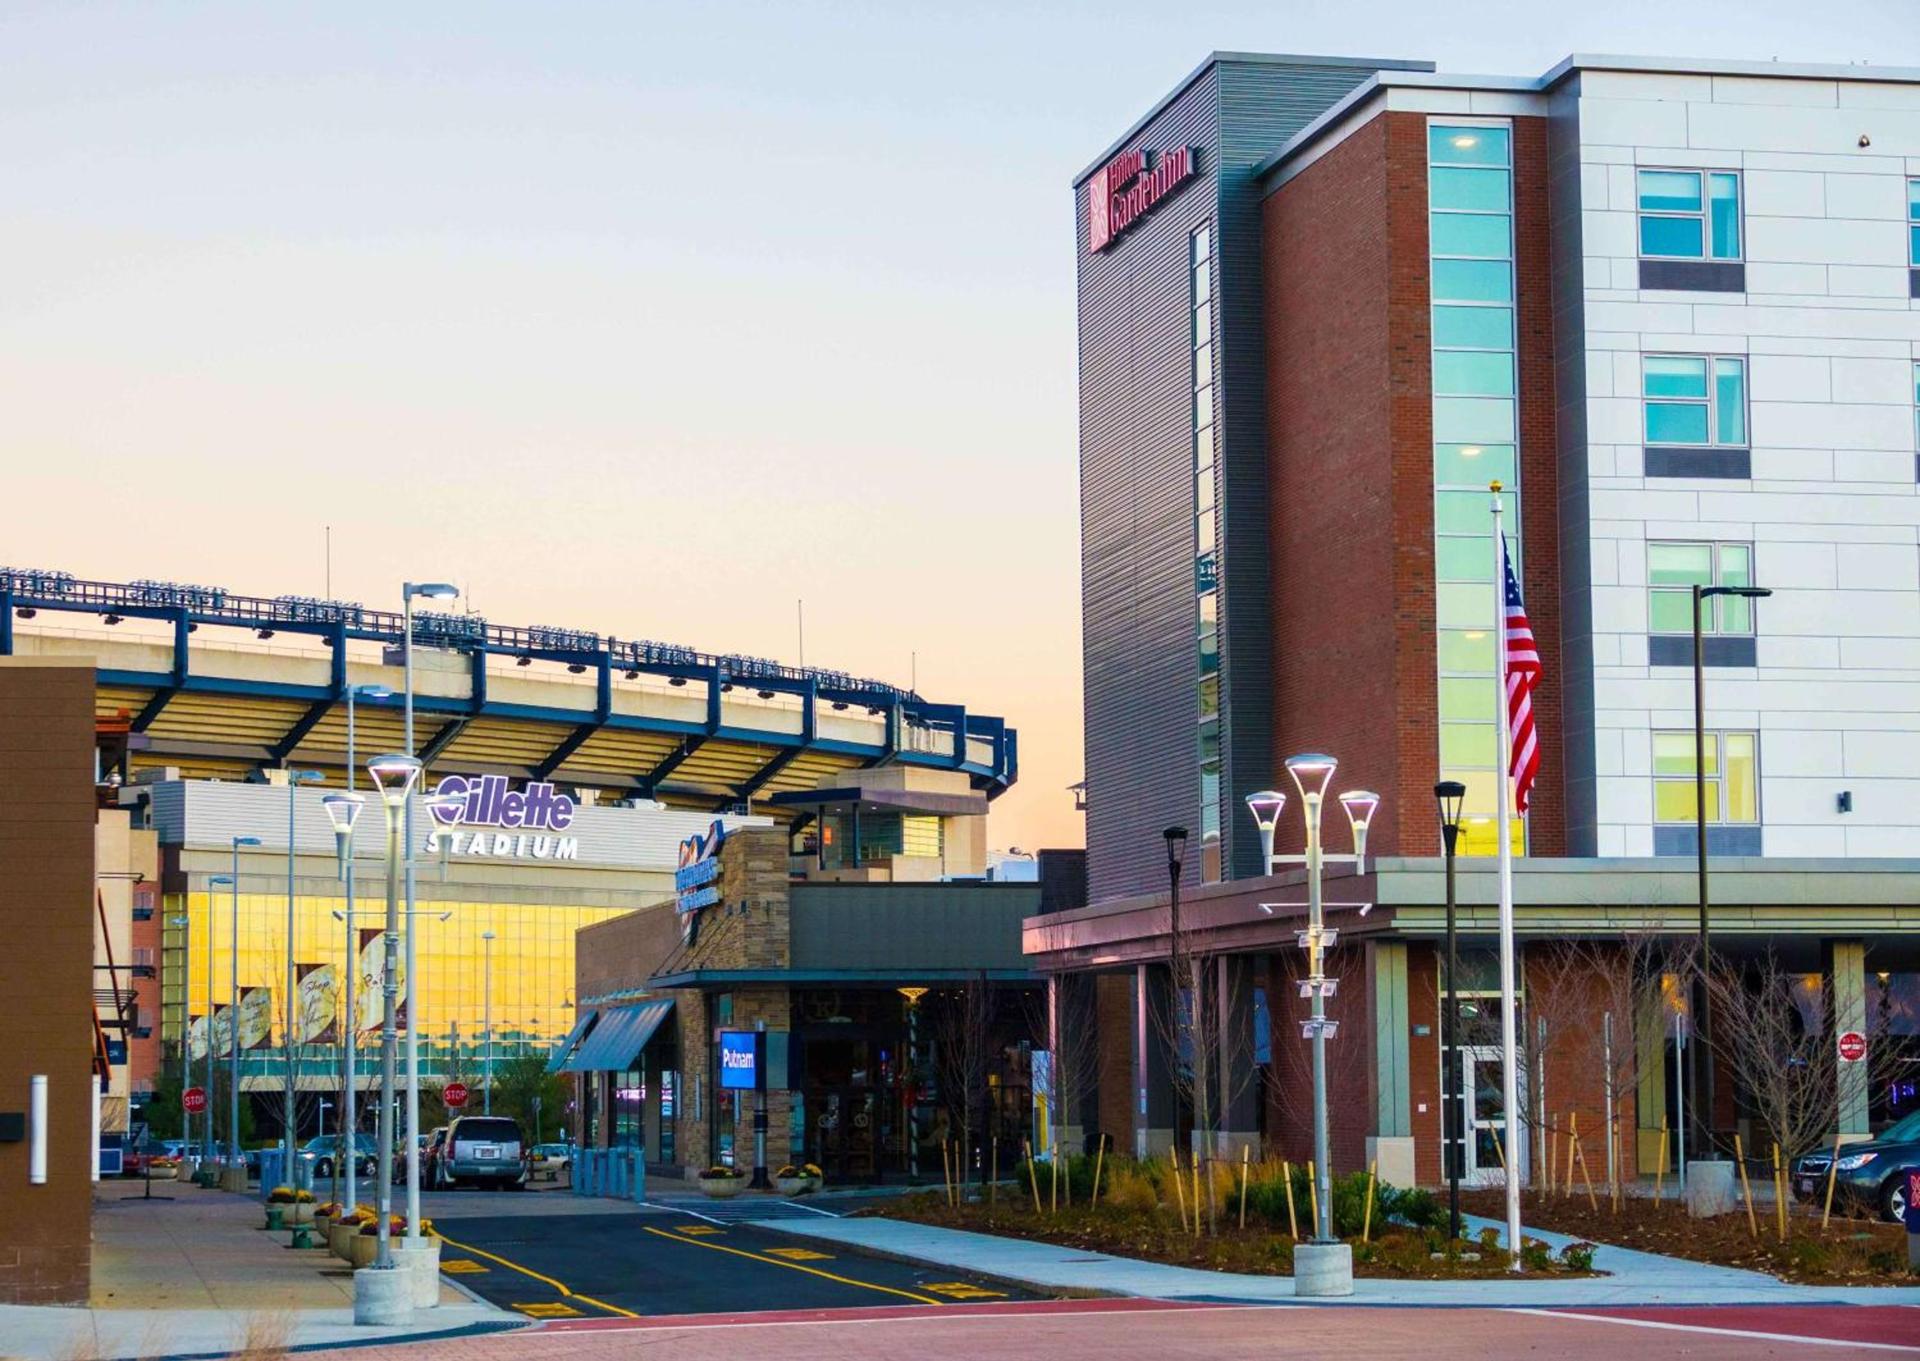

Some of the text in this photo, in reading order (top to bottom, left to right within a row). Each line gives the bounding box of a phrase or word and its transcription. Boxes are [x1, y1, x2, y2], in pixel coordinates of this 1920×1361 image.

[1110, 144, 1188, 236] Garden Inn
[435, 775, 574, 831] Gillette
[426, 831, 578, 860] STADIUM
[722, 1048, 754, 1068] Putnam
[445, 1089, 467, 1100] STOP
